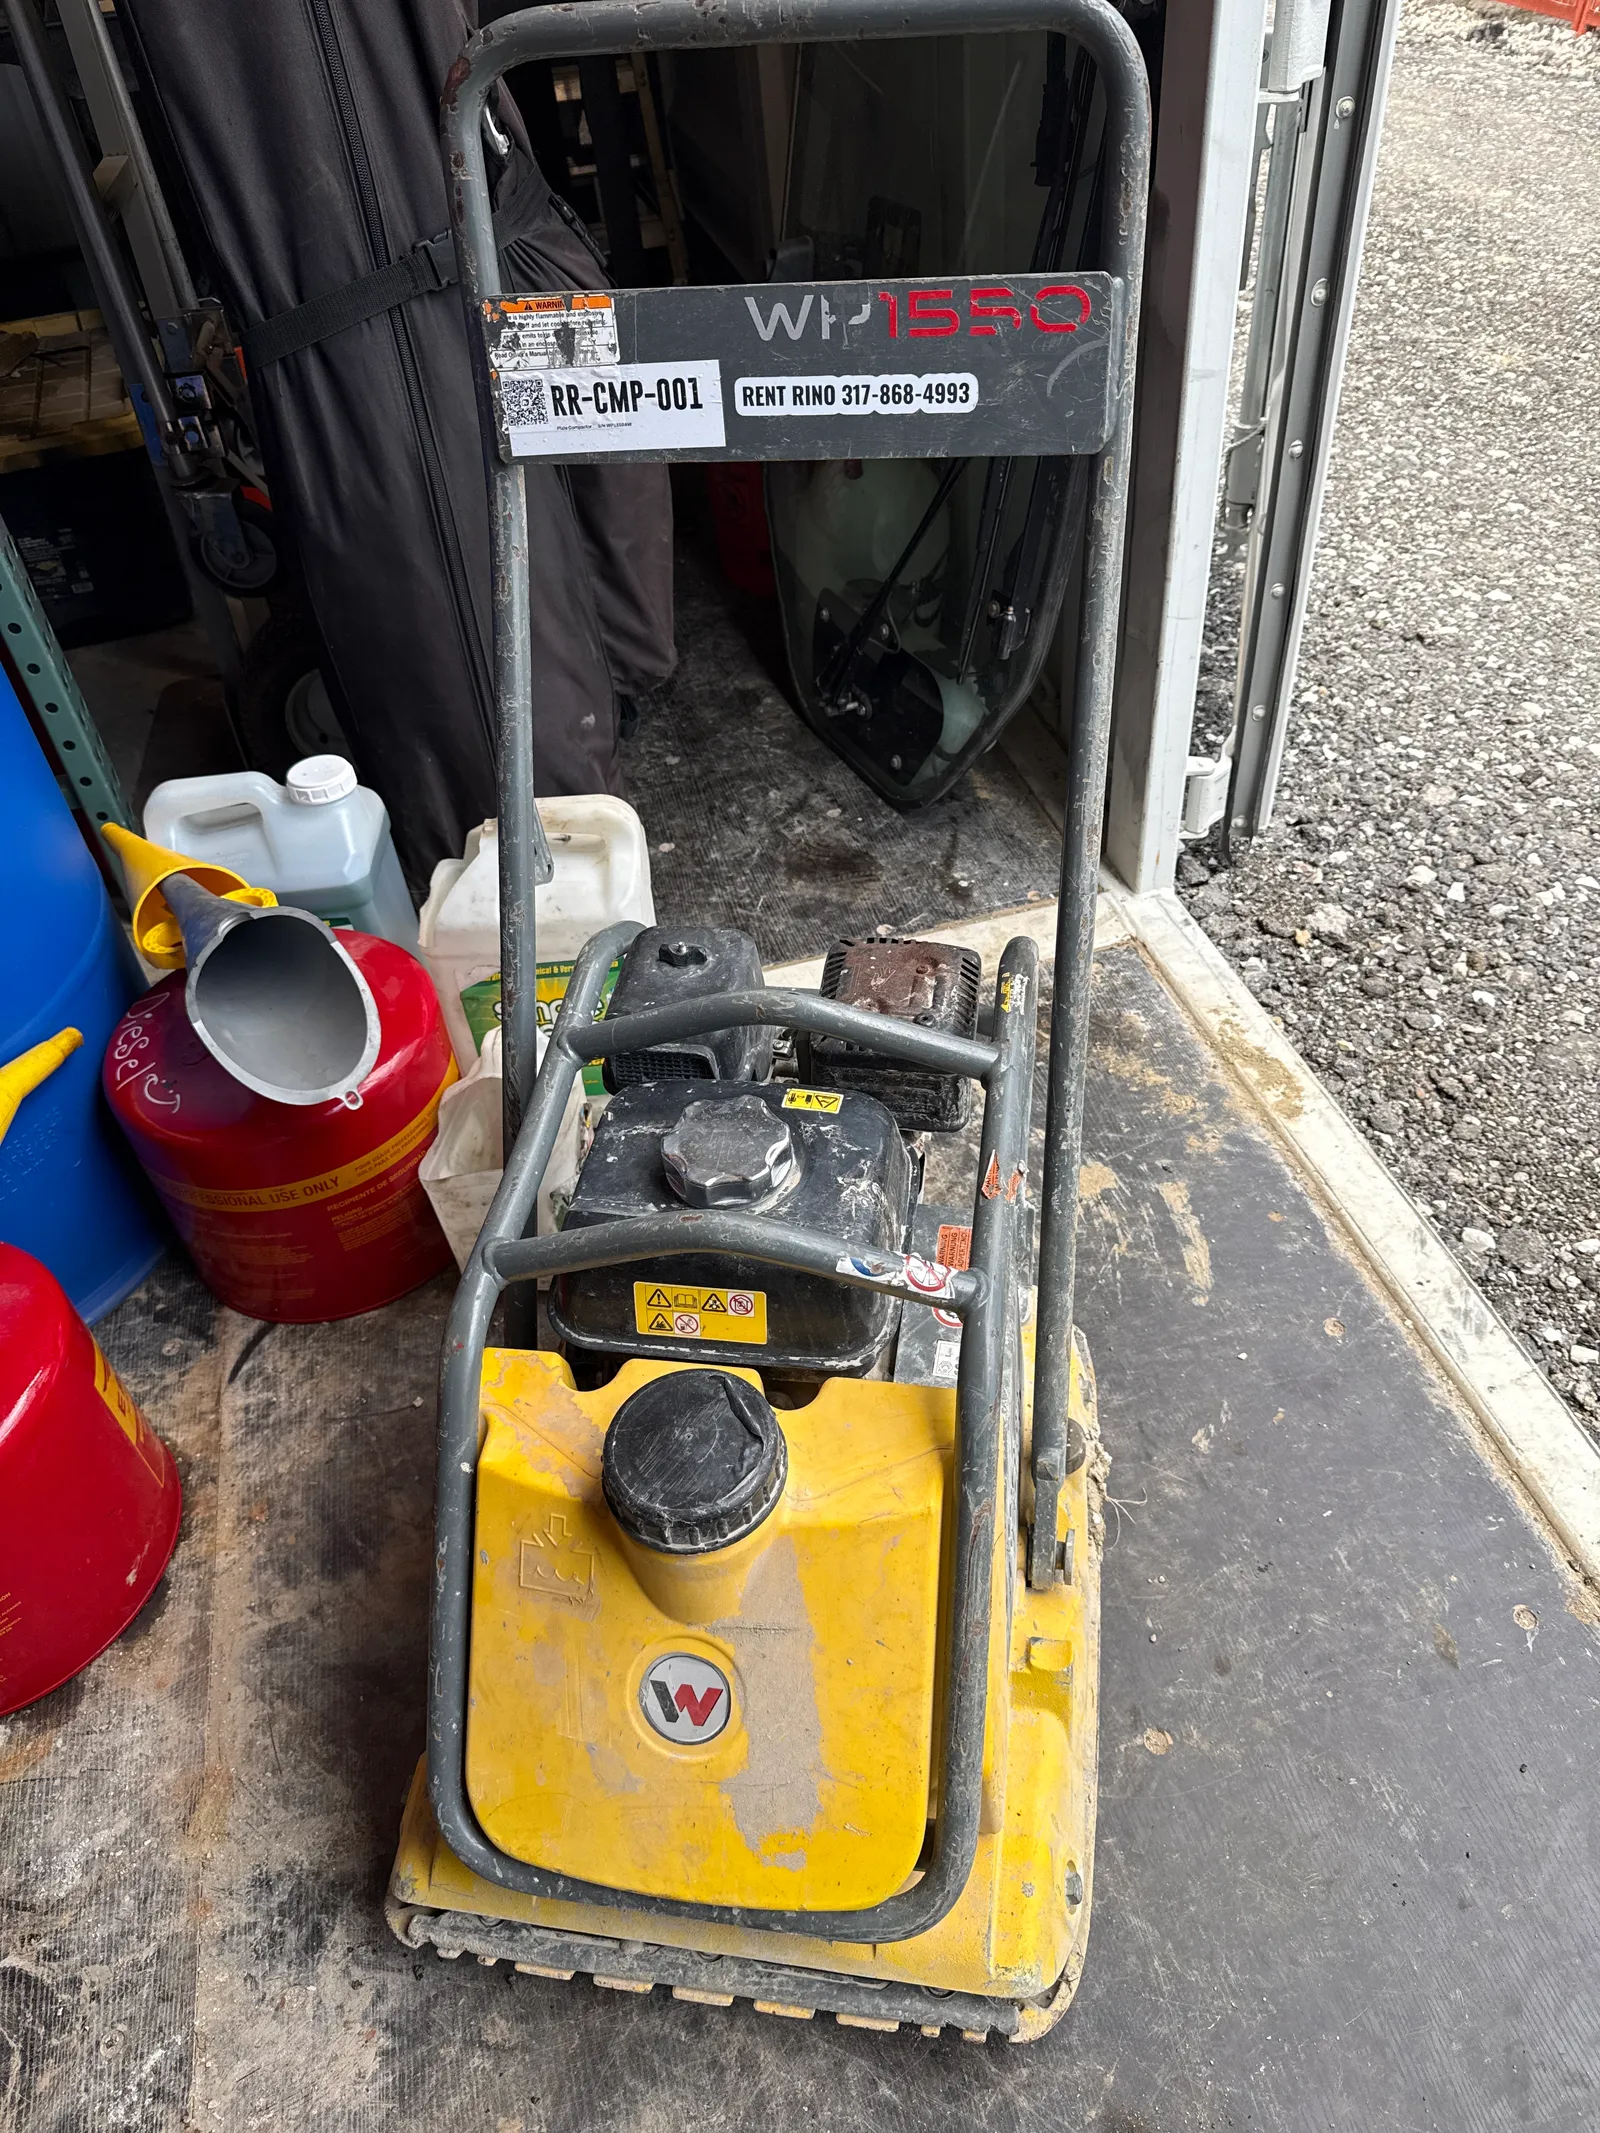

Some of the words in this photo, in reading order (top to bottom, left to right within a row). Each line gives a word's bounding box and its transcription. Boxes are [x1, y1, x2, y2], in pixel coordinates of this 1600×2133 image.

[519, 313, 535, 321] highly
[535, 298, 566, 311] WARNIN
[550, 377, 703, 416] RR-CMP-001
[742, 385, 786, 407] RENT
[792, 384, 835, 406] RINO
[841, 382, 970, 405] 317-868-4993
[115, 992, 170, 1091] Diesel
[270, 1189, 300, 1204] USE
[303, 1176, 340, 1198] ONLY
[326, 1186, 376, 1212] RECIPIENTE
[376, 1179, 388, 1190] DE
[937, 1233, 948, 1265] WARNG
